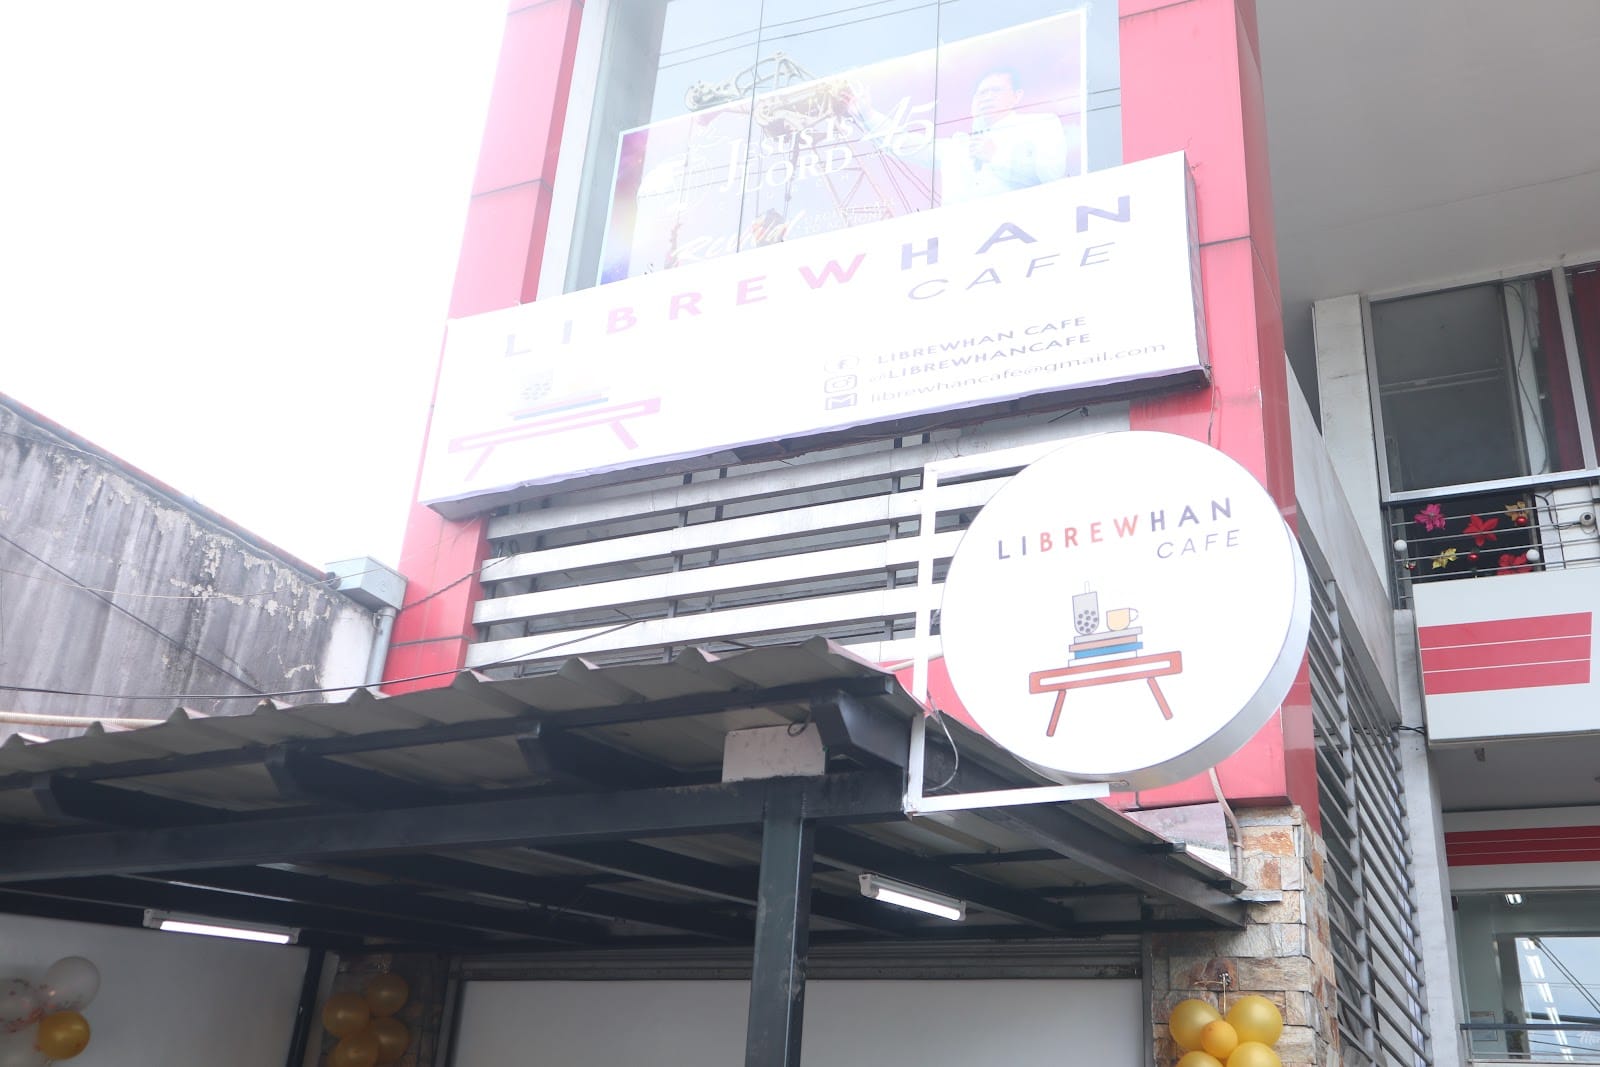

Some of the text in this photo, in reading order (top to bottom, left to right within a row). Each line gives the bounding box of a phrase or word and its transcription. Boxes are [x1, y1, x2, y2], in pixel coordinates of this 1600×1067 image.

[735, 145, 853, 196] LORD
[505, 195, 1131, 358] LIBREWHAN
[907, 241, 1117, 300] CAFE
[877, 316, 1087, 364] LIBREWHAN CAFE
[997, 497, 1233, 561] LIBREWHAN
[1156, 528, 1241, 560] CAFE
